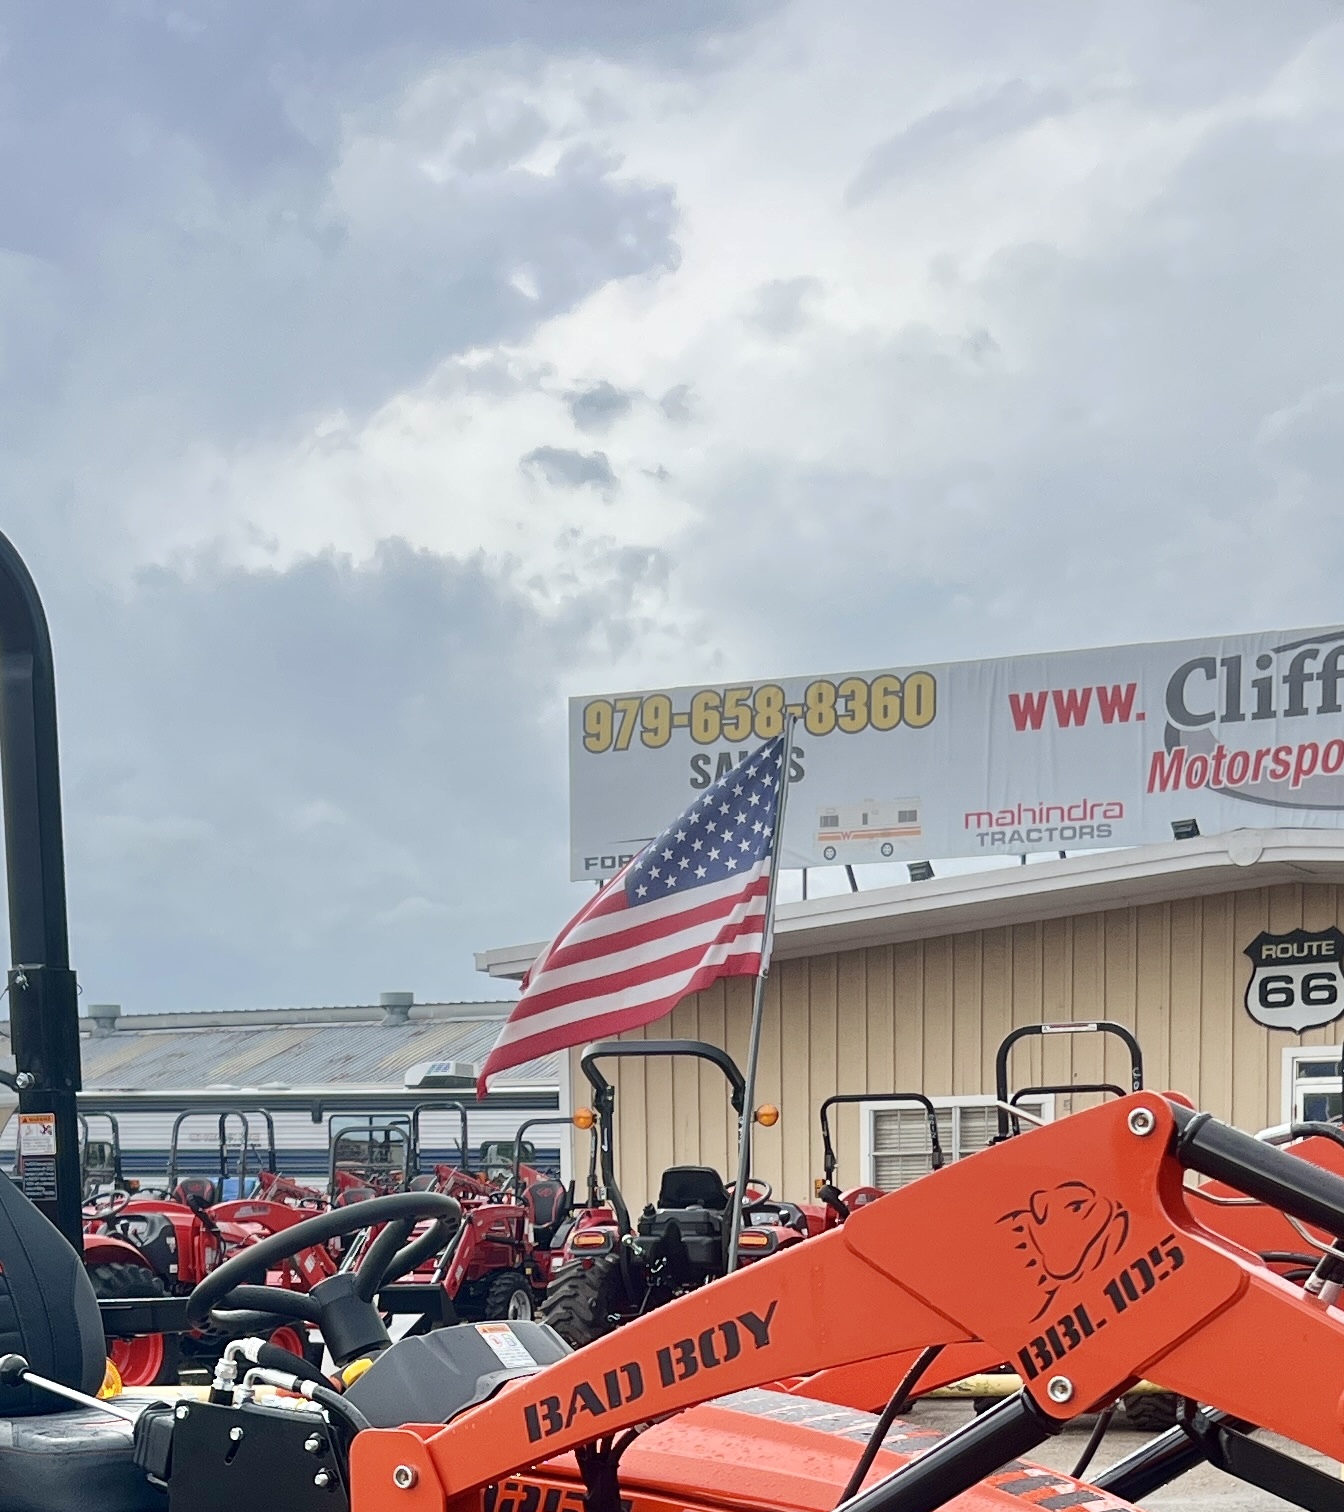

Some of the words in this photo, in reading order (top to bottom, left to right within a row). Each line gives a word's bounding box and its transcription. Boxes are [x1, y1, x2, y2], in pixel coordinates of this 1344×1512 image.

[582, 671, 937, 754] 979-658-8360
[689, 746, 805, 789] SAS
[964, 798, 1125, 831] mahindra
[975, 823, 1114, 849] TRACTORS
[1260, 938, 1336, 960] ROUTE
[1256, 972, 1338, 1009] 66
[1017, 1308, 1108, 1382] BBL
[1102, 1233, 1187, 1315] 105
[523, 1360, 645, 1444] BAD
[655, 1300, 779, 1390] BOY
